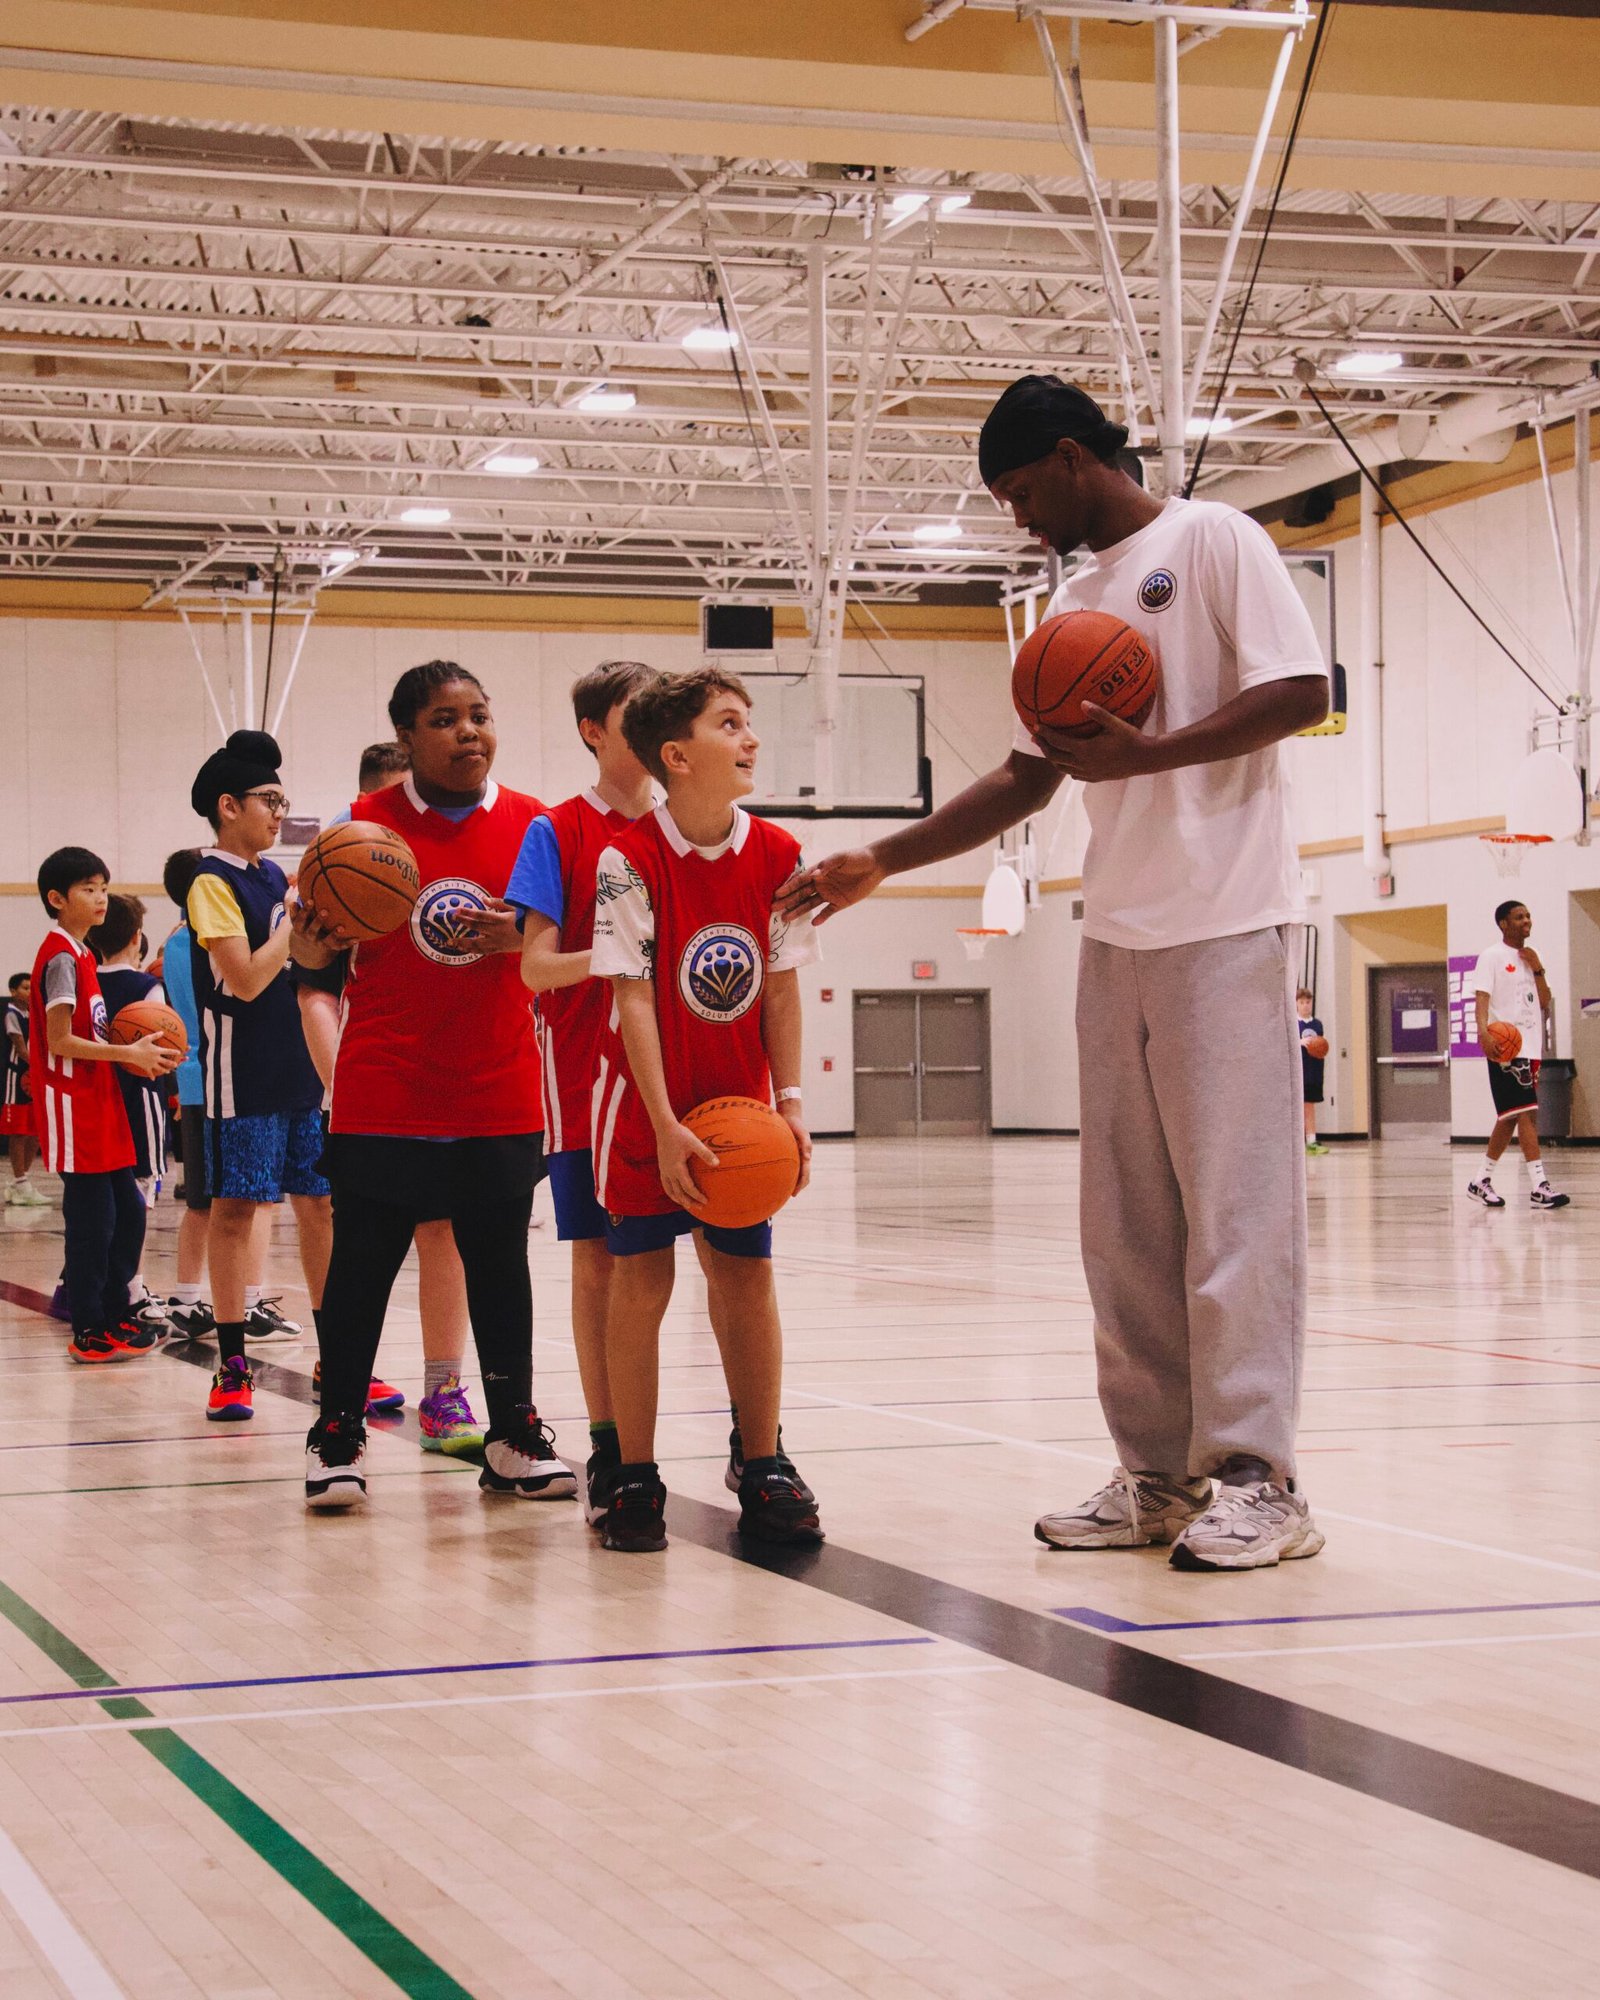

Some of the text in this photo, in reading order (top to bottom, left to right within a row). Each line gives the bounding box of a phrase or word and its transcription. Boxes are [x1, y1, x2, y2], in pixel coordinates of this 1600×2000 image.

[416, 882, 467, 909] COMMUNITY
[685, 928, 758, 961] COMMUNITY LINKS
[429, 951, 480, 963] SOLUTIONS
[700, 1003, 747, 1019] SOLUTIONS
